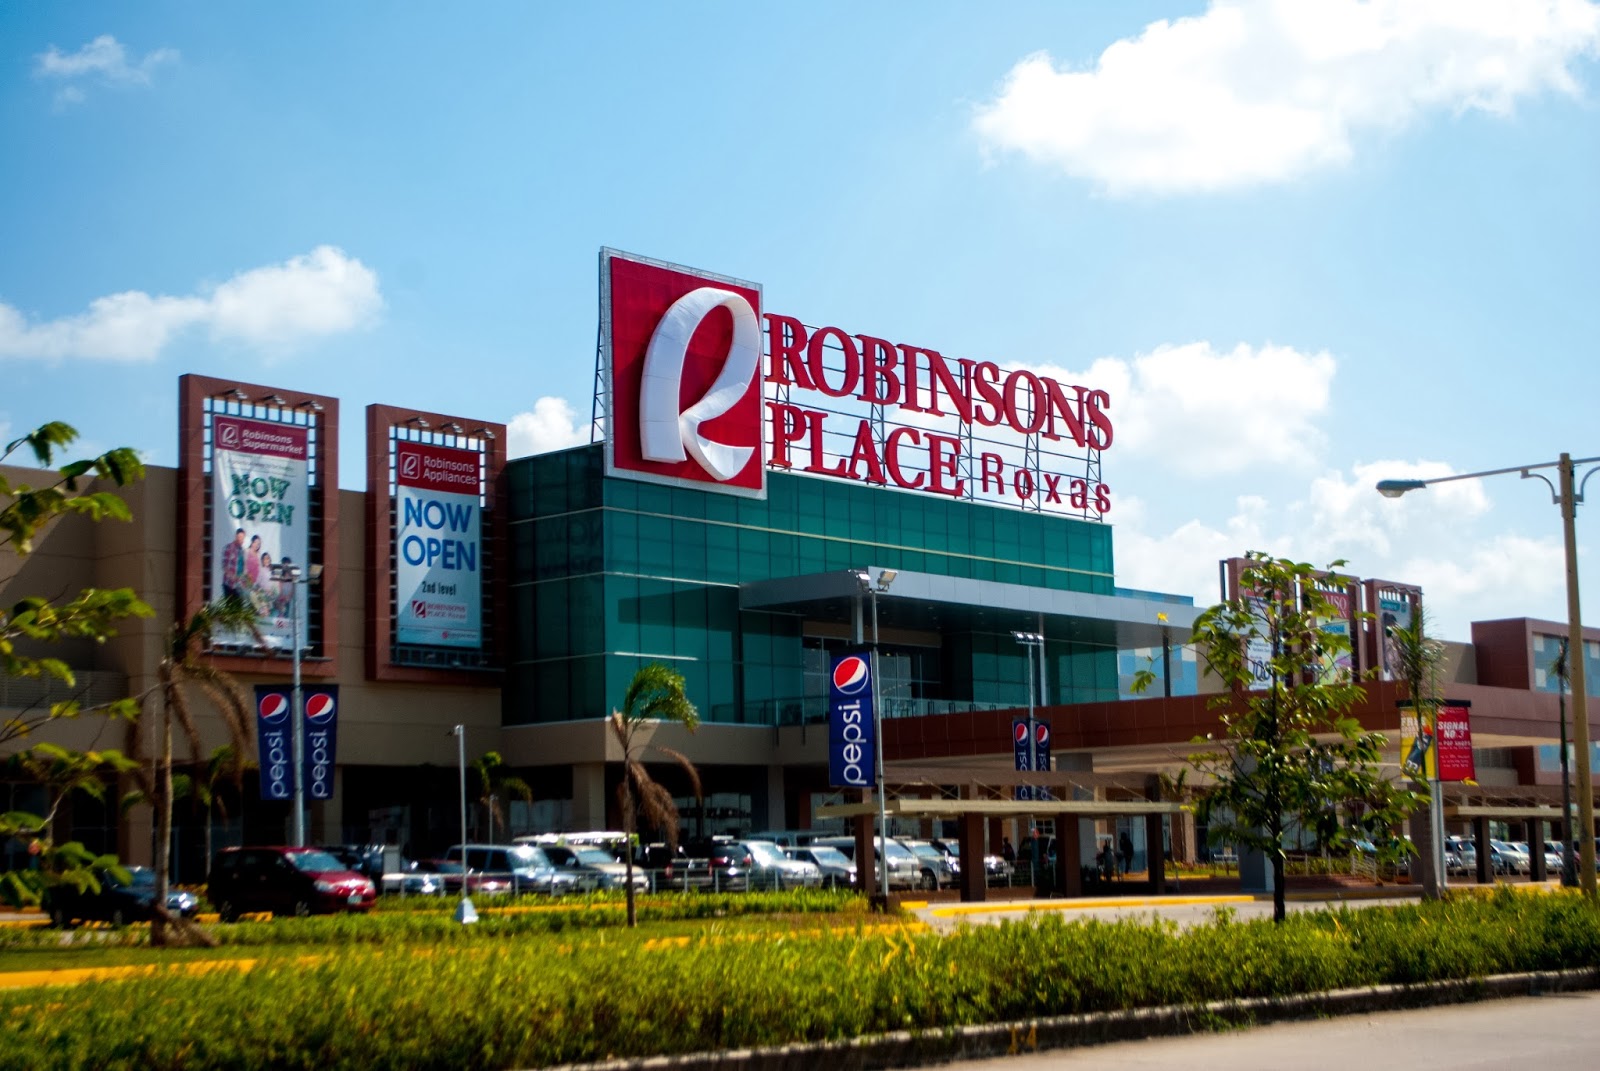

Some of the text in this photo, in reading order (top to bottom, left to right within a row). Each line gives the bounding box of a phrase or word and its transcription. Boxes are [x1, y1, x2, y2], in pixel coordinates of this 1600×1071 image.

[763, 313, 1113, 451] ROBINSONS
[242, 429, 293, 444] Robinsons
[242, 438, 303, 455] Supermarket
[423, 456, 475, 473] Robinsons
[765, 402, 1111, 513] PLACE Roxas
[231, 473, 290, 500] NOW
[422, 468, 478, 485] Appliances
[228, 498, 294, 526] OPEN
[404, 497, 472, 533] NOW
[402, 535, 476, 572] OPEN
[422, 581, 457, 596] 2nd level
[1437, 721, 1469, 732] SIGNAL
[838, 700, 867, 784] pepsi
[264, 730, 289, 798] pepsi
[309, 729, 330, 798] pepsi
